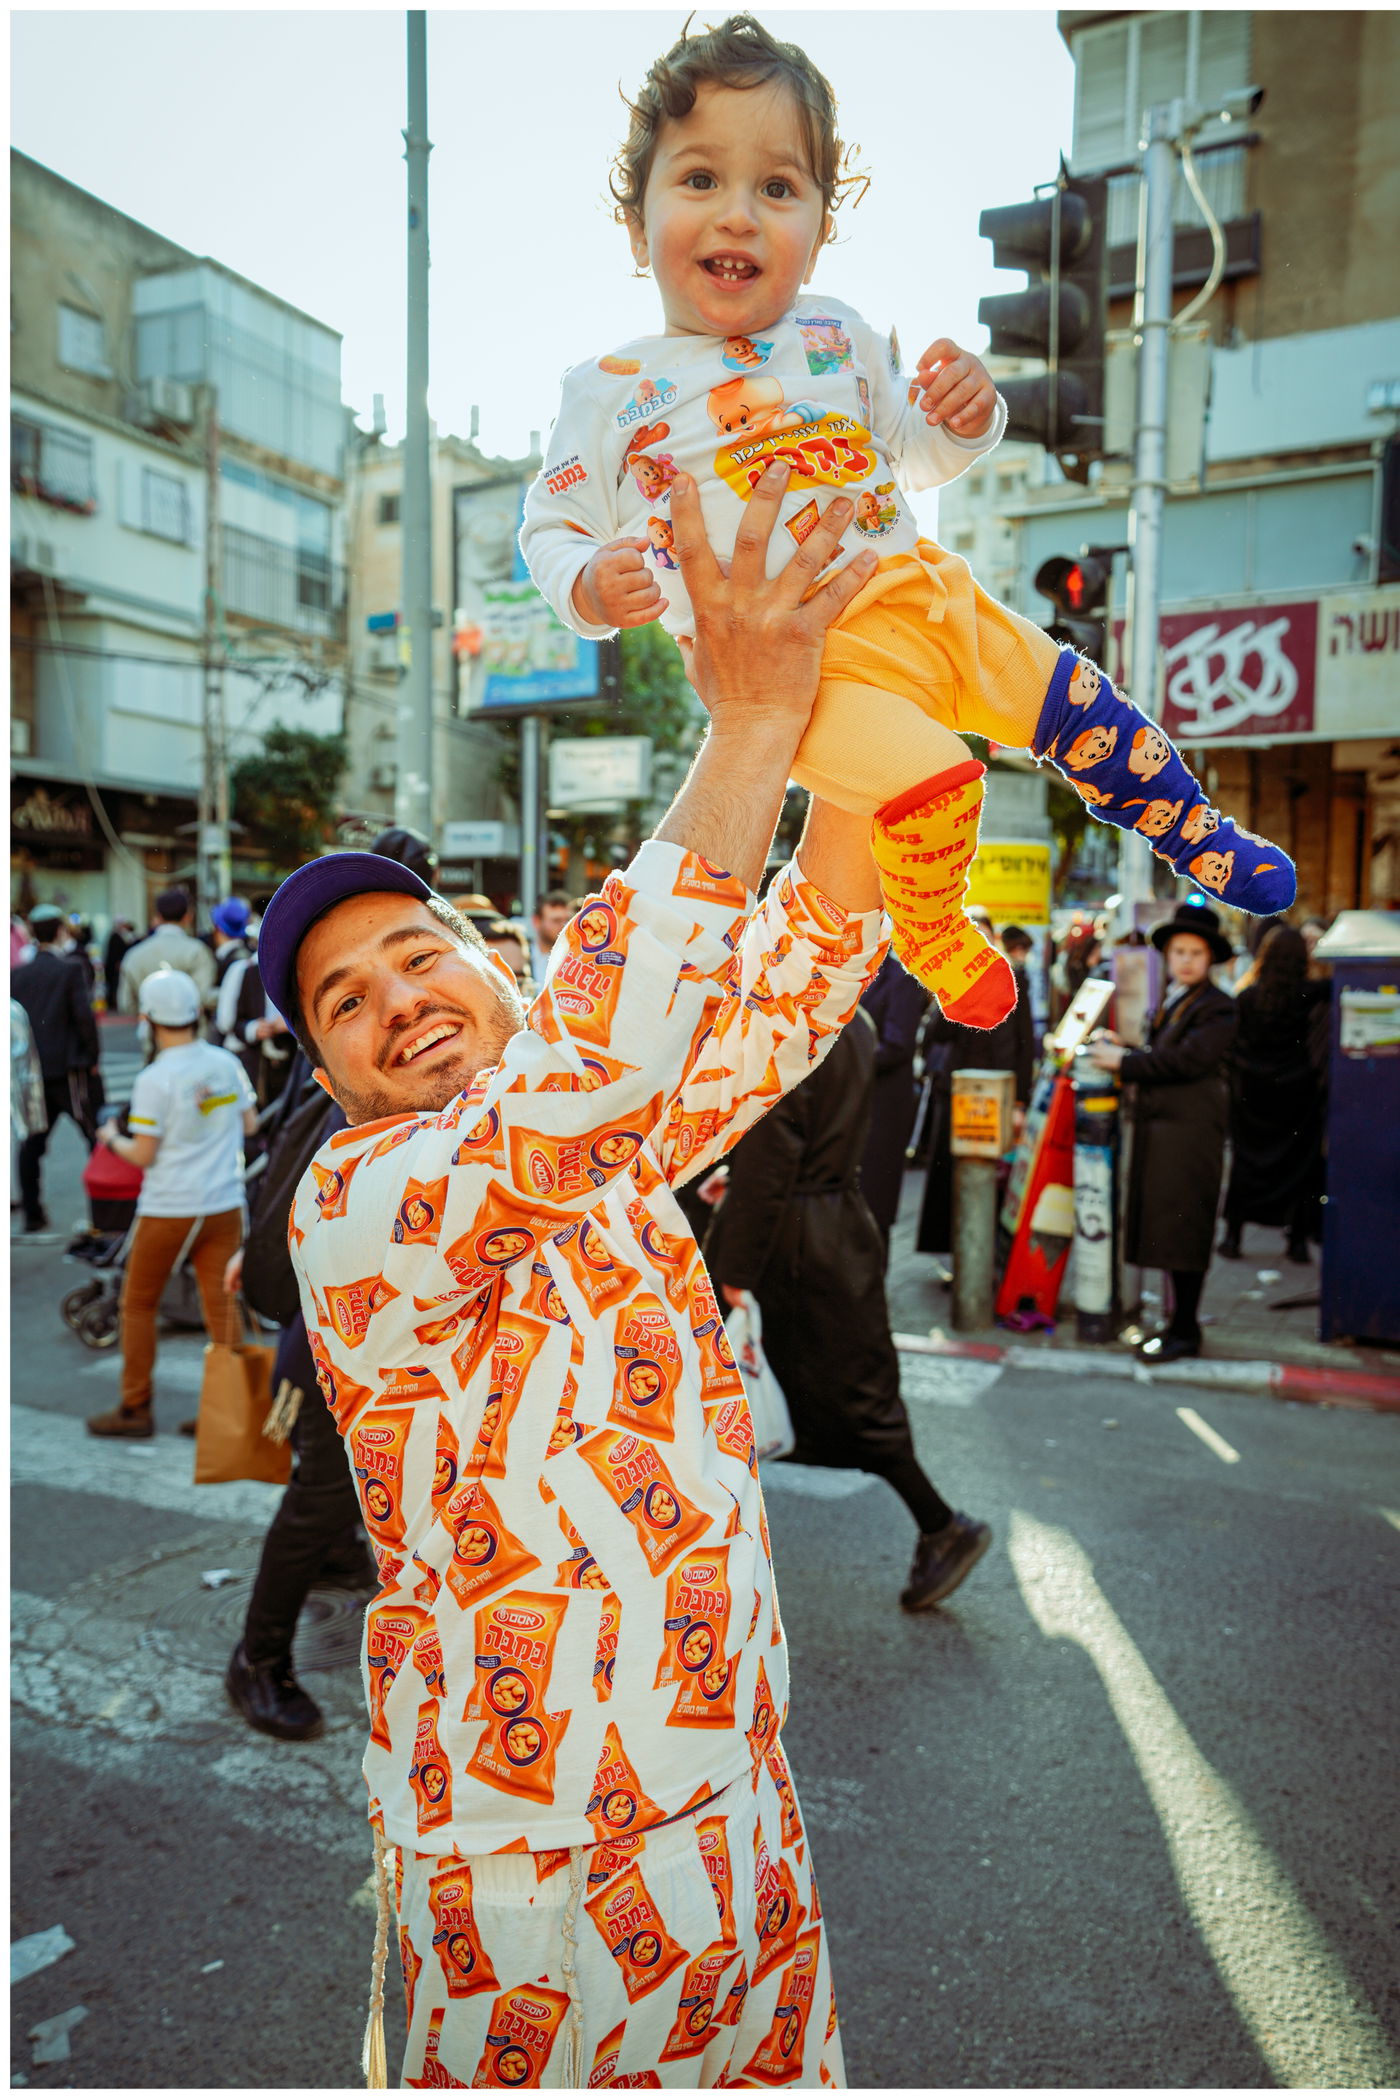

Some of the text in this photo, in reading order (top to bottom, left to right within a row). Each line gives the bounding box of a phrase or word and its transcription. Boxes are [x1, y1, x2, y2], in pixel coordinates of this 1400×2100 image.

[641, 1313, 667, 1325] אסם
[690, 1568, 713, 1580] אסם
[508, 1613, 537, 1627] אסם
[522, 2003, 545, 2017] אסם
